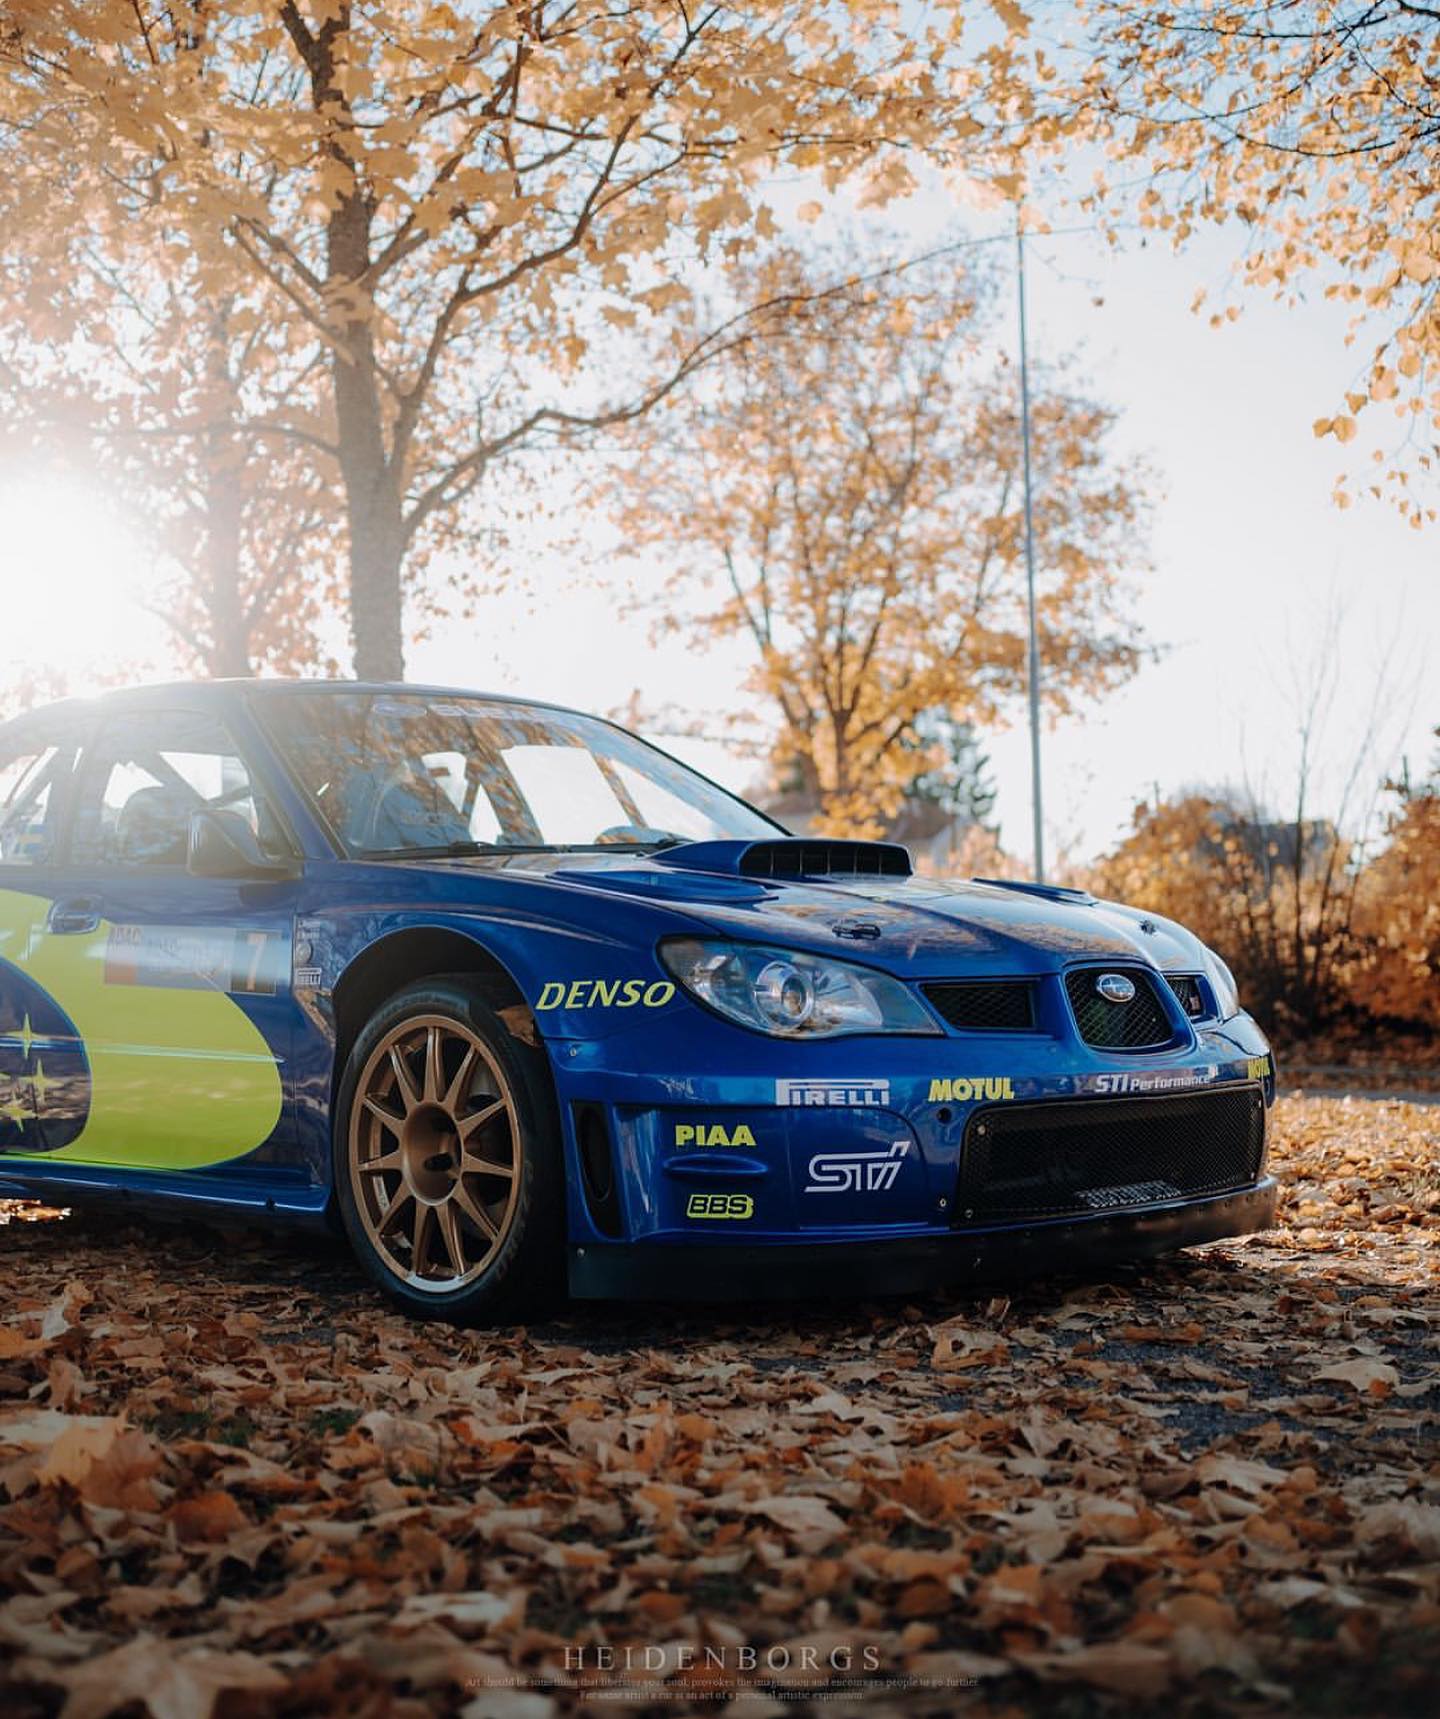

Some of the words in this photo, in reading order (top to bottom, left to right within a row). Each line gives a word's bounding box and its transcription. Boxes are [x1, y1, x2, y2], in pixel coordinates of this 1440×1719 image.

[247, 932, 268, 992] 7
[535, 980, 677, 1012] DENSO
[775, 1079, 890, 1106] PIRELLI
[928, 1078, 1015, 1102] MOTUL
[1130, 1074, 1212, 1092] Performance
[675, 1125, 757, 1147] PIAA
[686, 1195, 754, 1219] BBS
